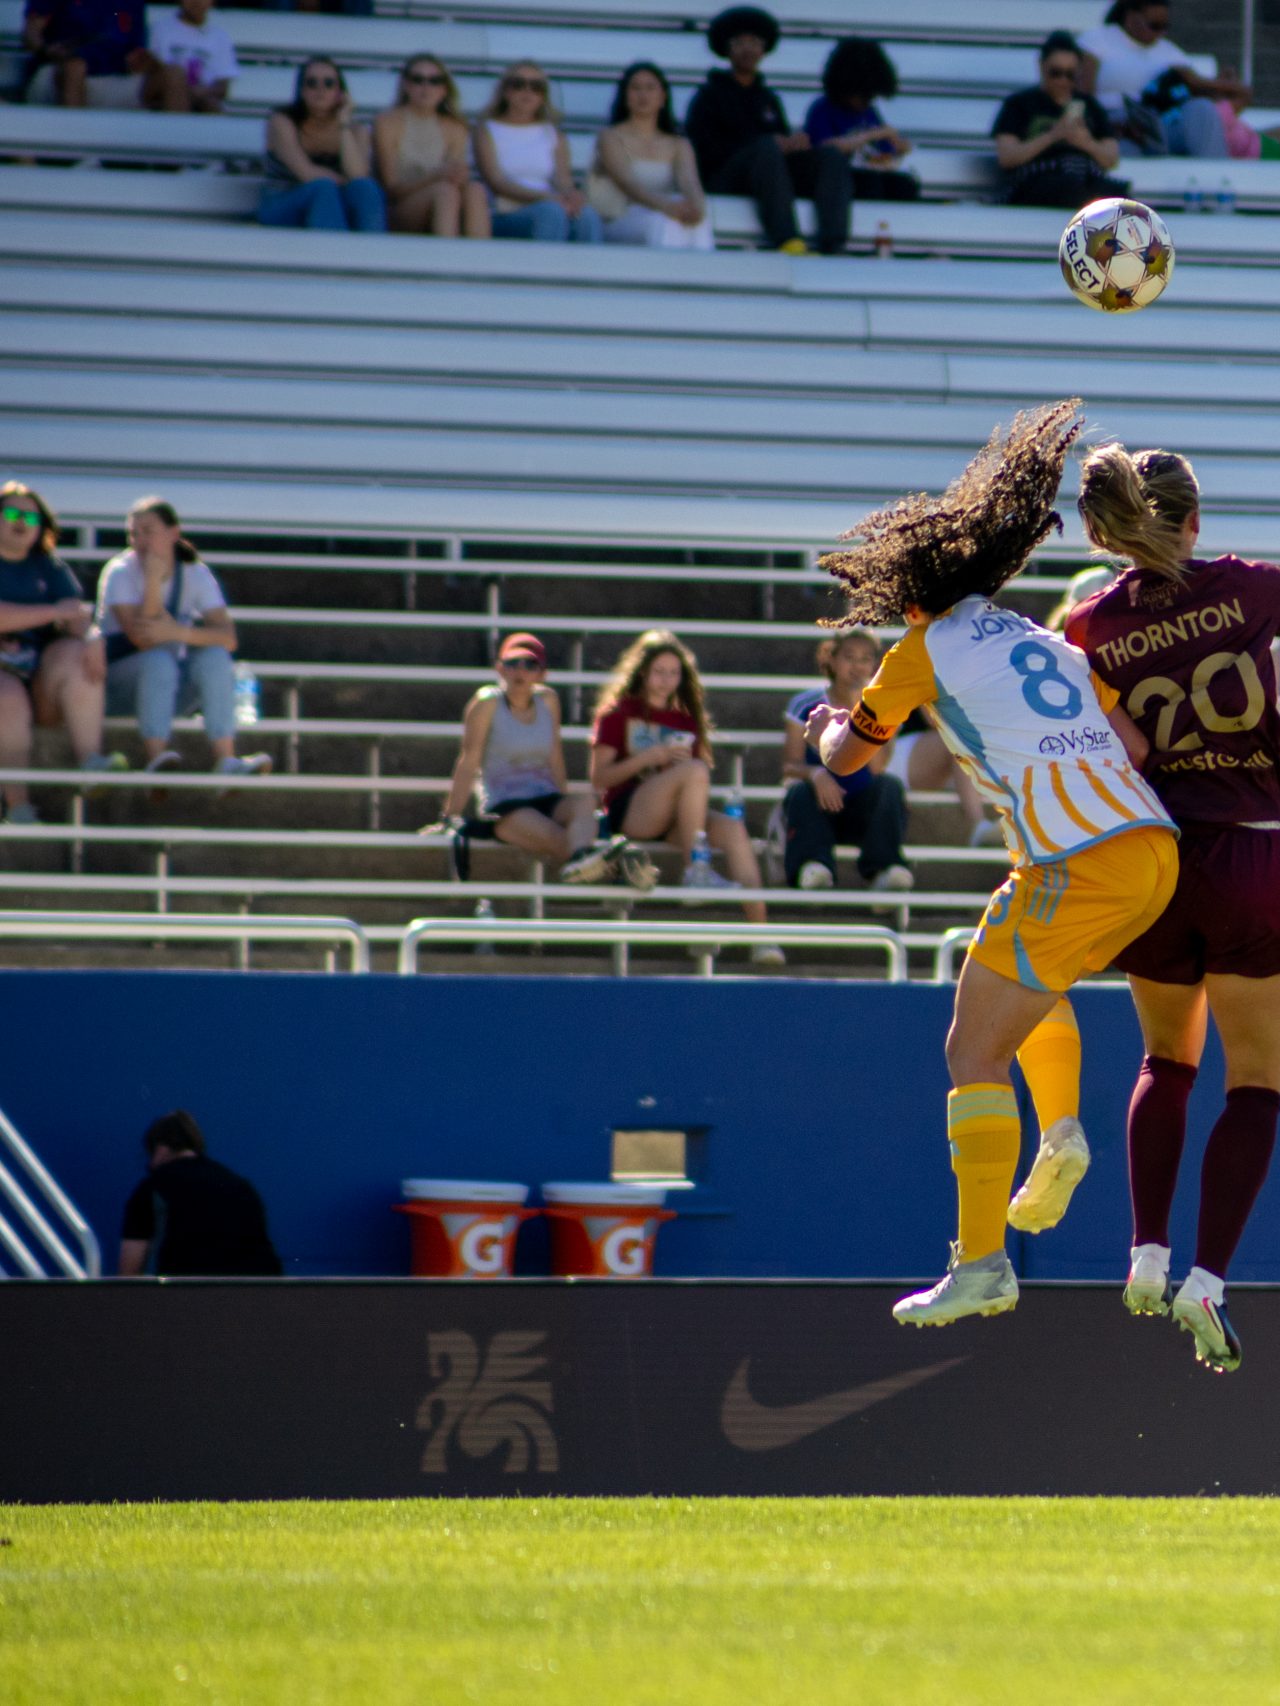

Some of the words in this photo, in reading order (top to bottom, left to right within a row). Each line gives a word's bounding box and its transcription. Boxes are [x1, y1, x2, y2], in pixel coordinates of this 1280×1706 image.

[1066, 230, 1100, 289] SELECT
[971, 616, 1030, 640] JON
[1096, 599, 1246, 671] THORNTON
[1010, 641, 1083, 720] 8
[1127, 651, 1266, 751] 20
[1060, 727, 1110, 754] VyStar
[461, 1222, 503, 1272] G
[603, 1226, 644, 1275] G
